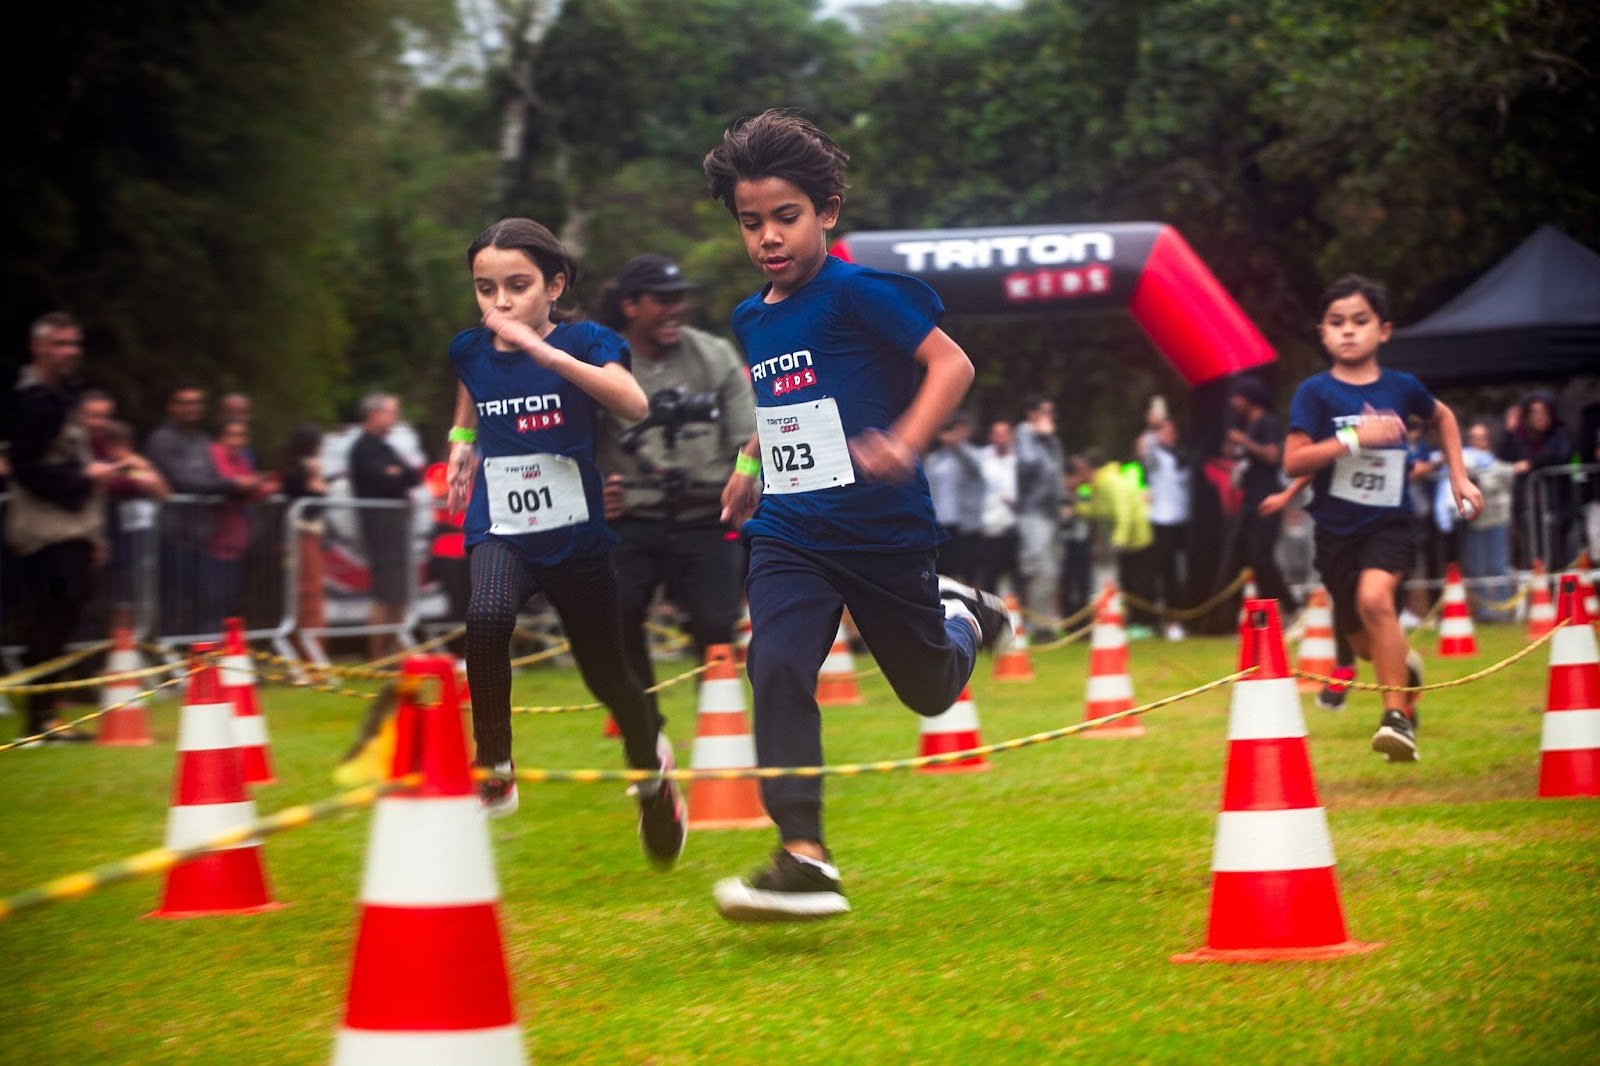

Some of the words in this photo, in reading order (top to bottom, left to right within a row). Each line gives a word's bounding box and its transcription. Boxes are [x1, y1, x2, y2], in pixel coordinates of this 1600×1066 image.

[893, 231, 1115, 272] TRITON
[751, 349, 813, 383] RITON
[476, 393, 562, 417] TRITON
[771, 442, 816, 473] 023
[507, 485, 553, 515] 001
